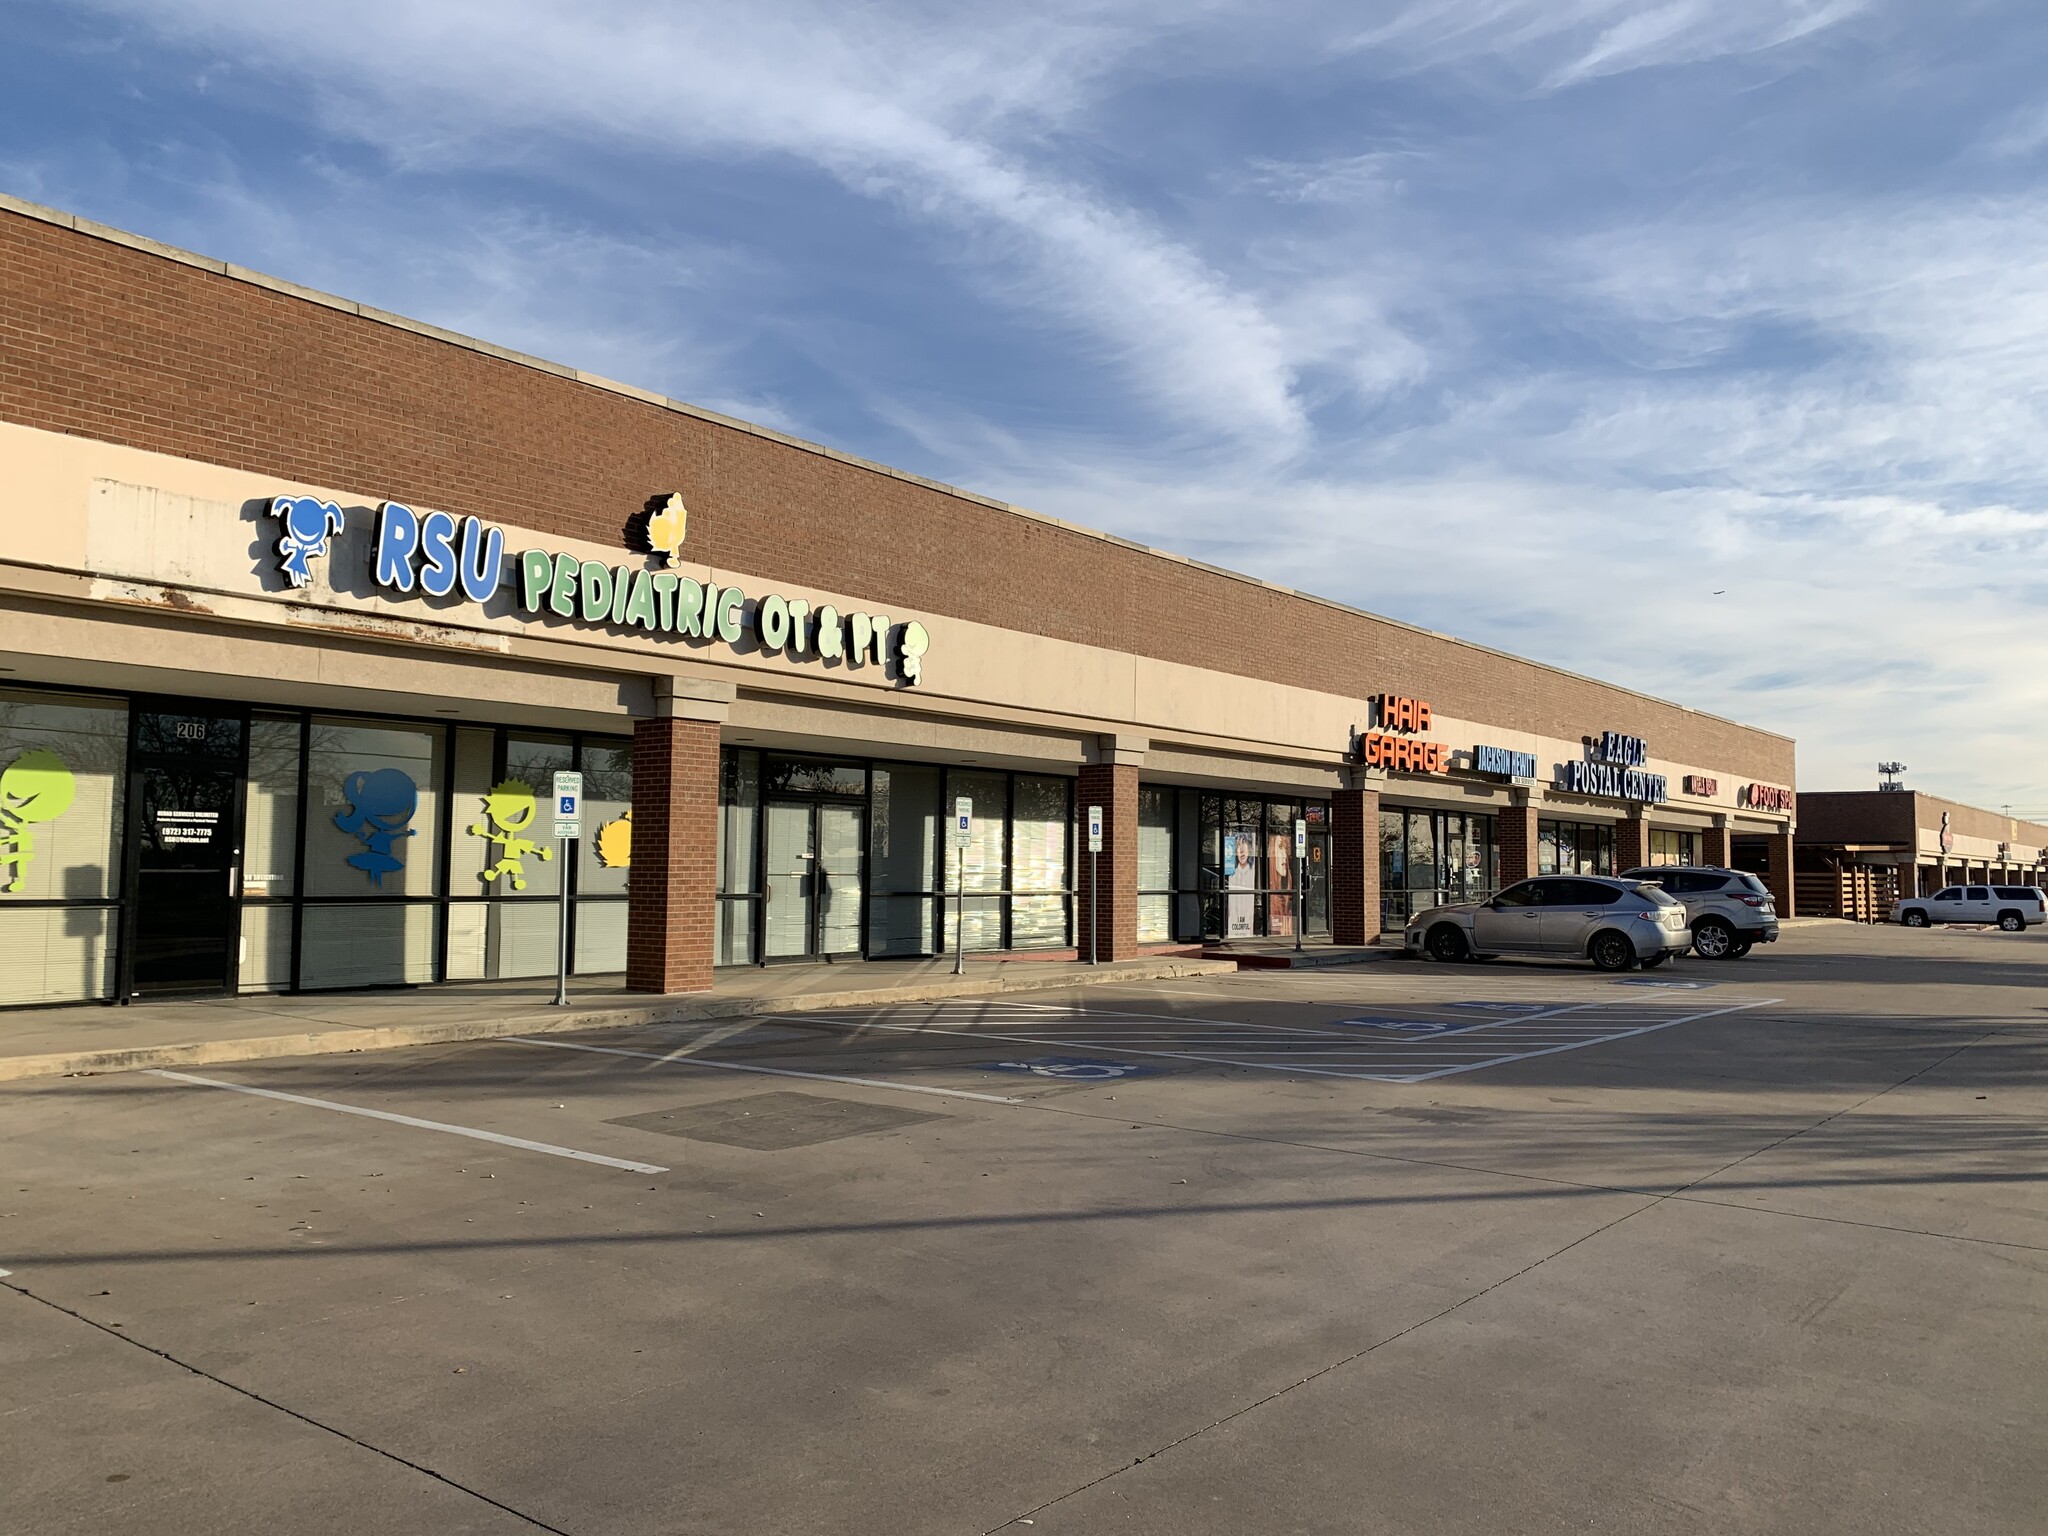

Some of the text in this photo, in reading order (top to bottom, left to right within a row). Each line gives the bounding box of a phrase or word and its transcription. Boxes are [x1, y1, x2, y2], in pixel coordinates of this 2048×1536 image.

[375, 500, 505, 604] RSU
[522, 548, 891, 666] PEDIATRIC OT & PT
[1382, 694, 1432, 732] HAIR
[177, 723, 205, 739] 206
[1364, 733, 1449, 774] GARAGE
[1478, 745, 1537, 778] JACKSON HEWITT
[1605, 731, 1648, 769] EAGLE
[556, 776, 580, 784] RESERVED
[557, 784, 579, 792] PARKING
[1572, 760, 1621, 798] POSTAL
[1624, 769, 1668, 804] CENTER
[1760, 785, 1793, 810] FOOT SPA
[162, 827, 181, 836] (972)
